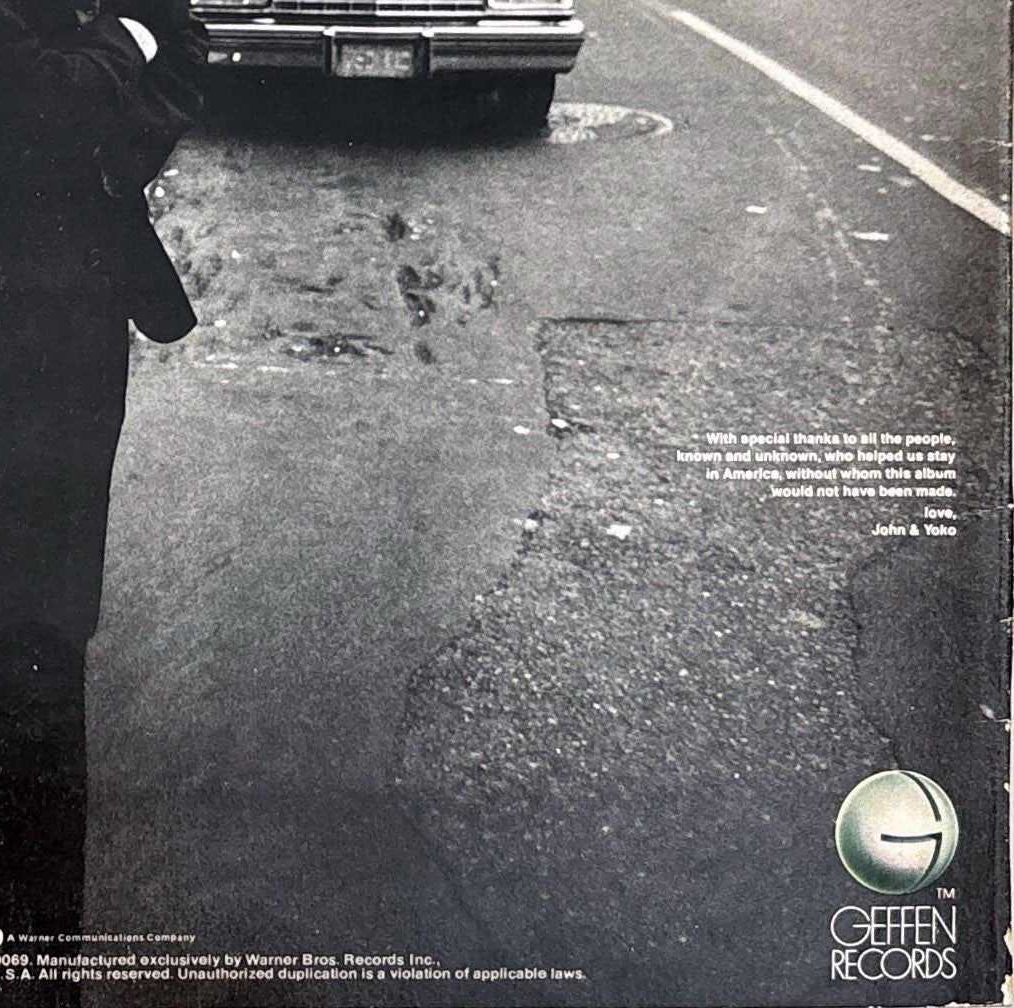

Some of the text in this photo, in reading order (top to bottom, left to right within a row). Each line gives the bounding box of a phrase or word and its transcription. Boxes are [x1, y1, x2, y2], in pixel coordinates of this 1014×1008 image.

[706, 433, 956, 447] With special thanks to all the people,
[677, 450, 955, 465] known and unknown, who helped us stay
[706, 468, 956, 481] in America, without whom this album
[771, 485, 956, 498] would not have been made.
[924, 507, 956, 520] love,
[872, 524, 956, 536] John & Yoko
[936, 888, 955, 898] TM
[830, 906, 956, 946] GEFFEN
[7, 935, 15, 944] A
[18, 935, 54, 944] Warner
[58, 935, 144, 944] Communications
[147, 934, 196, 945] Company
[36, 954, 136, 967] Manufactured
[141, 954, 220, 968] exclusively
[224, 954, 241, 968] by
[245, 954, 298, 966] Warner
[302, 954, 339, 966] Bros.
[344, 954, 404, 966] Records
[831, 948, 956, 980] RECORDS
[38, 968, 58, 981] All
[62, 968, 102, 984] rights
[106, 968, 174, 980] reserved.
[178, 968, 274, 980] Unauthorized
[278, 968, 357, 984] duplication
[361, 968, 373, 980] is
[377, 971, 385, 980] a
[390, 968, 451, 980] violation
[455, 968, 470, 980] of
[473, 968, 547, 984] applicable
[550, 968, 586, 980] laws.
